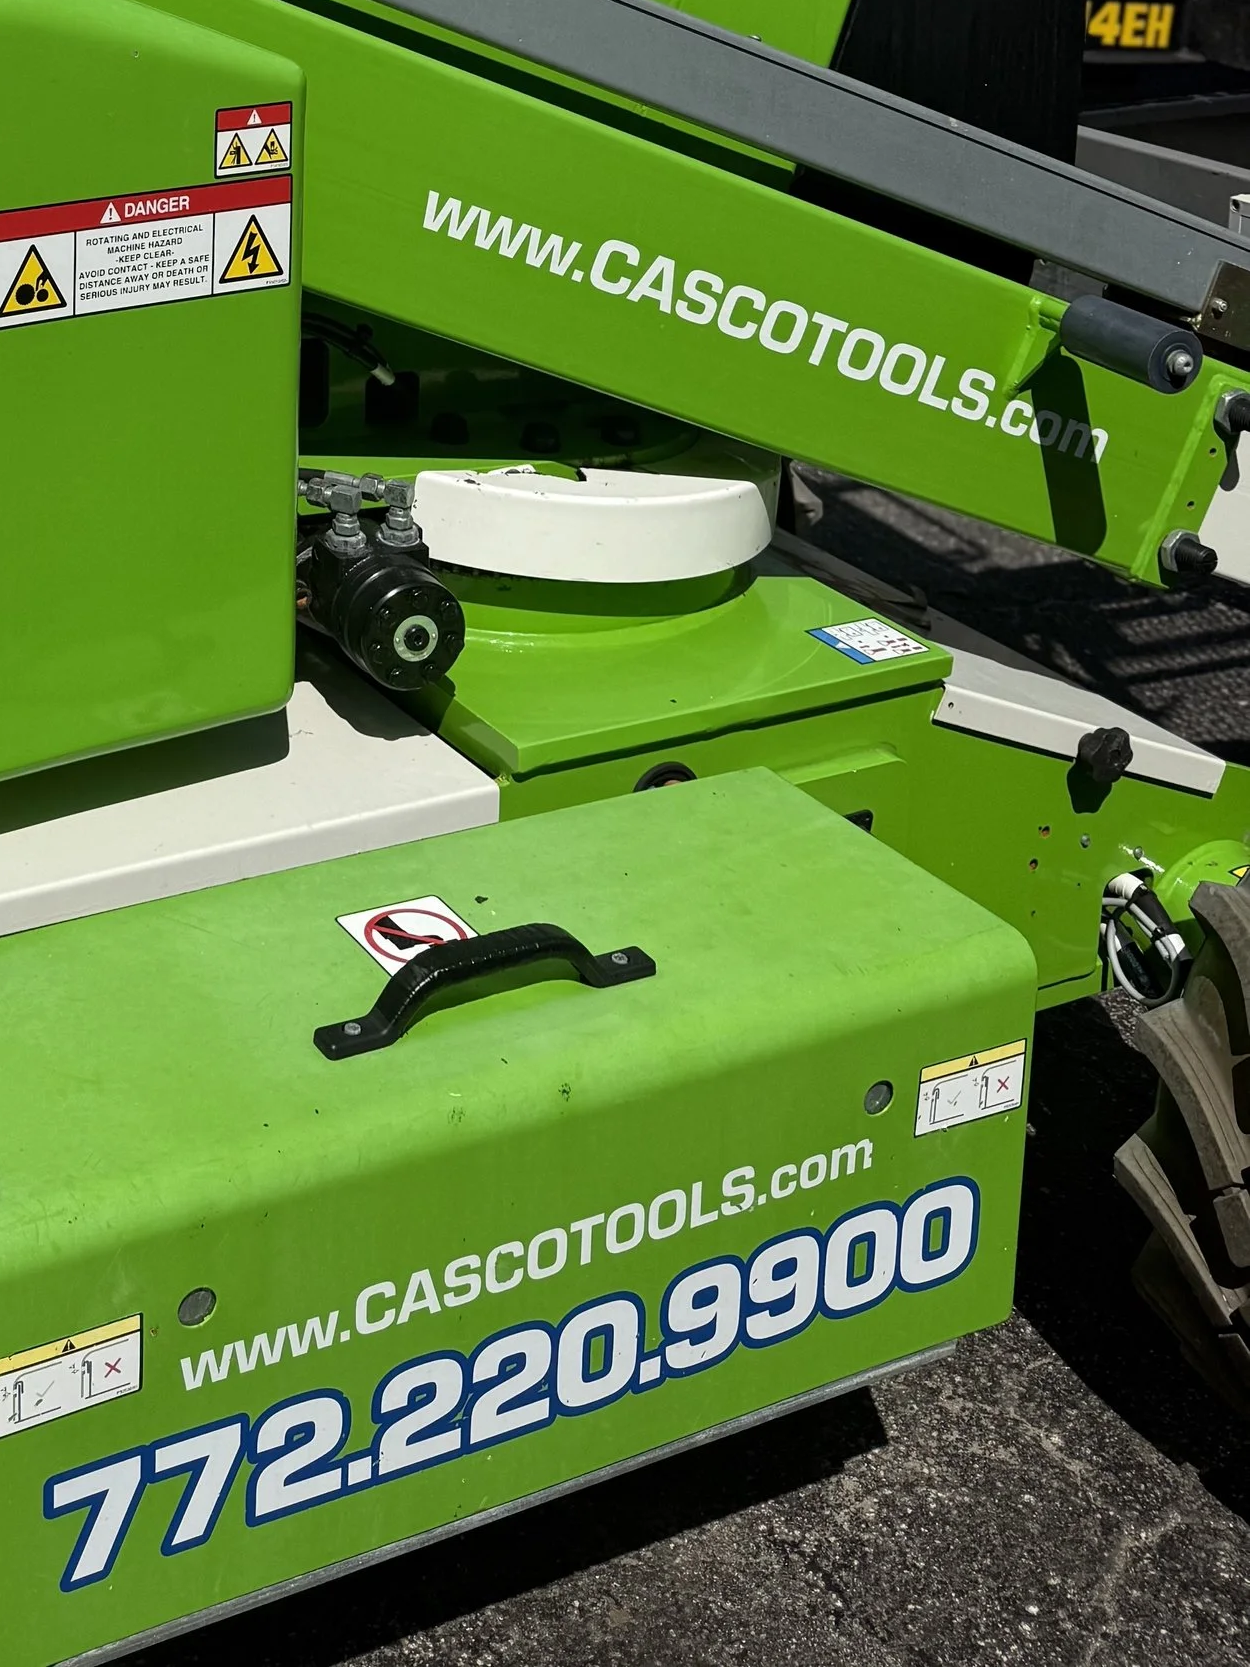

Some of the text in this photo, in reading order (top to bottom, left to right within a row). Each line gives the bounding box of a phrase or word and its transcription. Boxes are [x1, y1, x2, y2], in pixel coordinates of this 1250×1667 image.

[1085, 0, 1175, 48] 4EH
[124, 195, 190, 218] DANGER
[86, 224, 203, 246] ROTATING AND ELECTRICAL
[107, 237, 183, 254] MACHINE HAZARD
[79, 269, 105, 280] AVOID
[108, 263, 148, 276] CONTACT
[155, 258, 178, 269] KEEP
[180, 257, 186, 265] A
[188, 254, 210, 264] SAFE
[79, 264, 208, 290] DISTANCE AWAY OR DEATH OR
[80, 276, 208, 301] SERIOUS INJURY MAY RESULT.
[423, 190, 1109, 464] www.CASCOTOOLS.com
[180, 1139, 873, 1390] www.CASCOTOOLS.com
[44, 1176, 981, 1592] 772.220.9900
